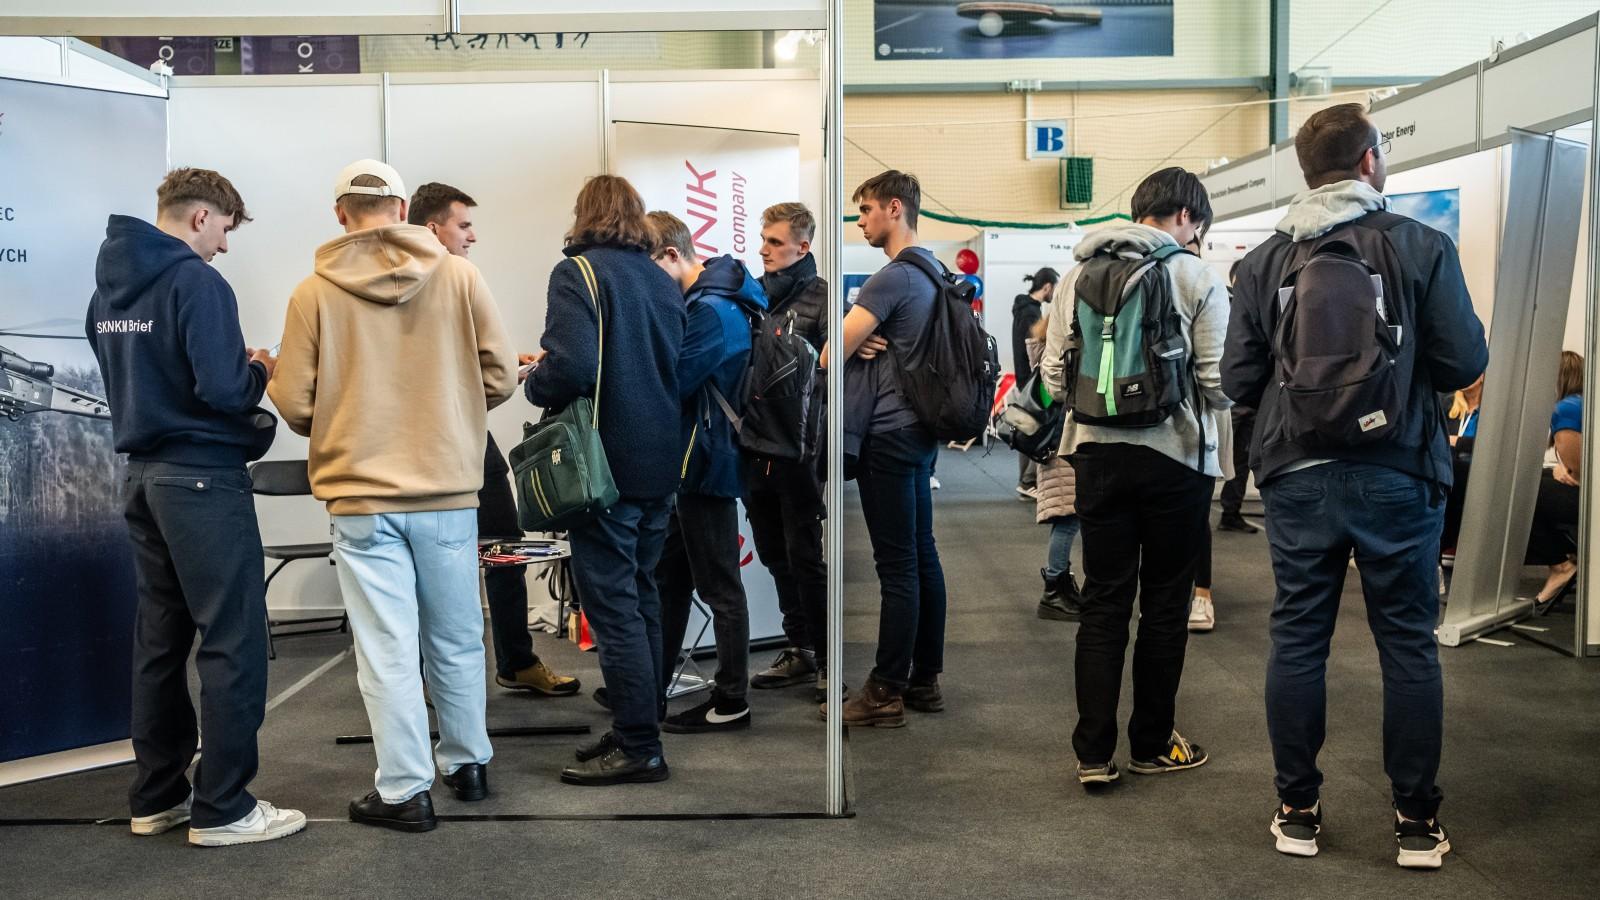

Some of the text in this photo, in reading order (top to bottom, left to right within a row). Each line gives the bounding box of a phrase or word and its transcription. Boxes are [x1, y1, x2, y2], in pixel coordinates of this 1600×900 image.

[1036, 127, 1064, 152] B
[1249, 177, 1266, 189] Company
[685, 159, 719, 262] NIK
[731, 171, 748, 254] company
[128, 319, 154, 333] Brief
